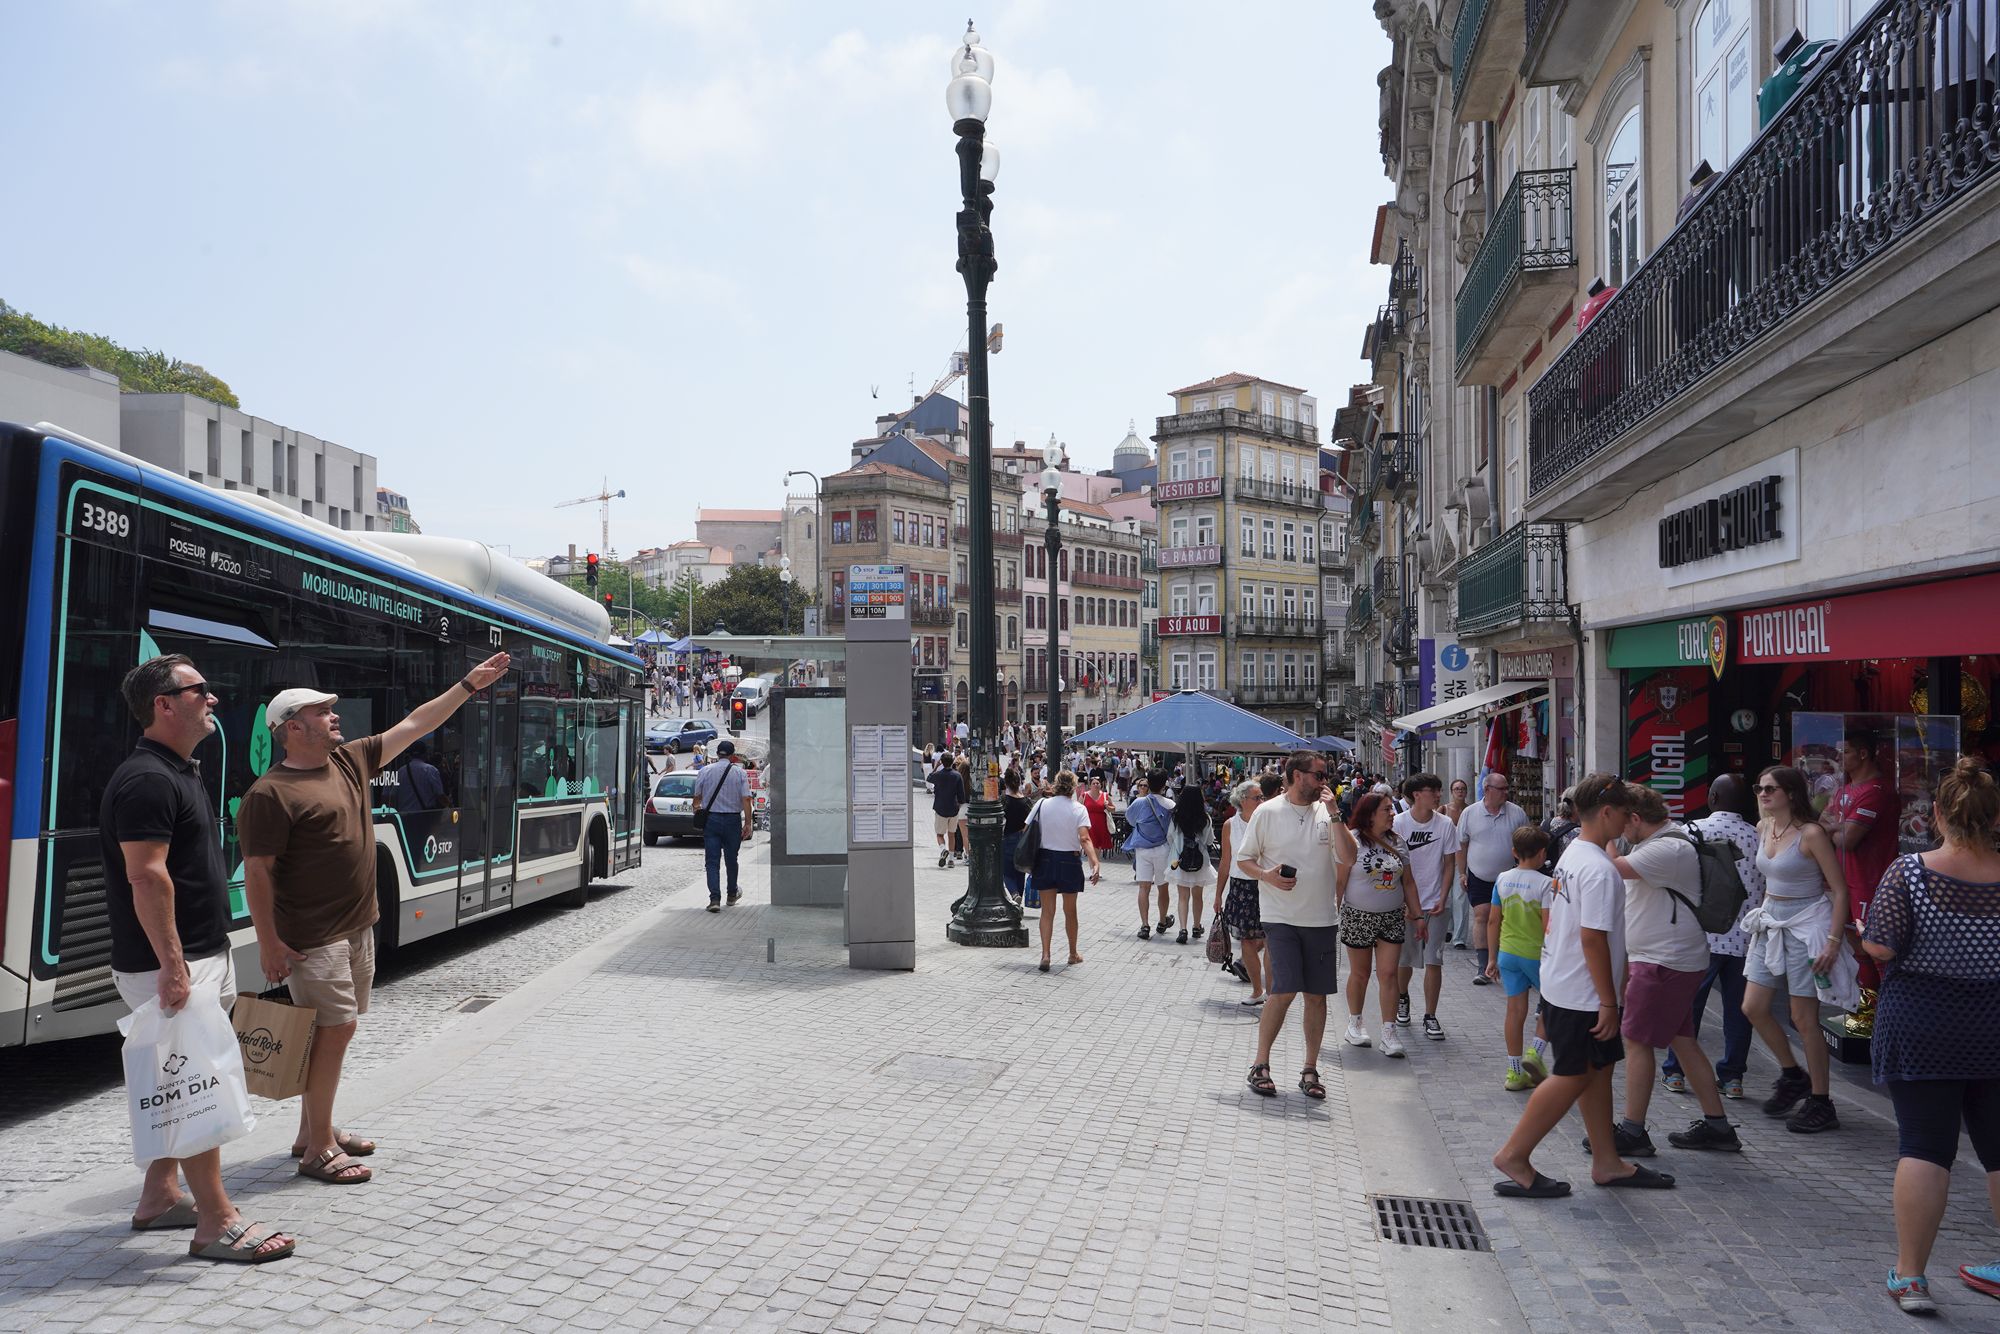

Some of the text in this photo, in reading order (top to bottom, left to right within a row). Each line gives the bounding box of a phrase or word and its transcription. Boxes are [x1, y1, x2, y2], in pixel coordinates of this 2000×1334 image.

[1159, 479, 1219, 498] VESTIR BEM
[82, 502, 130, 538] 3389
[1658, 475, 1783, 569] OFFICIAL STORE
[169, 538, 206, 559] POSEUR
[1162, 548, 1215, 563] E BARATO
[218, 558, 242, 575] 2020
[302, 572, 423, 624] MOBILIDADE INTELIGENTE
[1169, 617, 1209, 632] SÓ AQUI
[1678, 620, 1709, 664] FORÇ
[1444, 679, 1455, 737] OFIAL
[438, 841, 452, 854] STCP
[1409, 831, 1433, 843] NIKE
[1363, 848, 1379, 874] MICKEY
[237, 1031, 283, 1054] Hard Rock
[140, 1076, 220, 1110] BOM DIA
[157, 1073, 201, 1091] QUINTA DO
[151, 1118, 180, 1130] PORTO
[187, 1104, 217, 1119] DOURO
